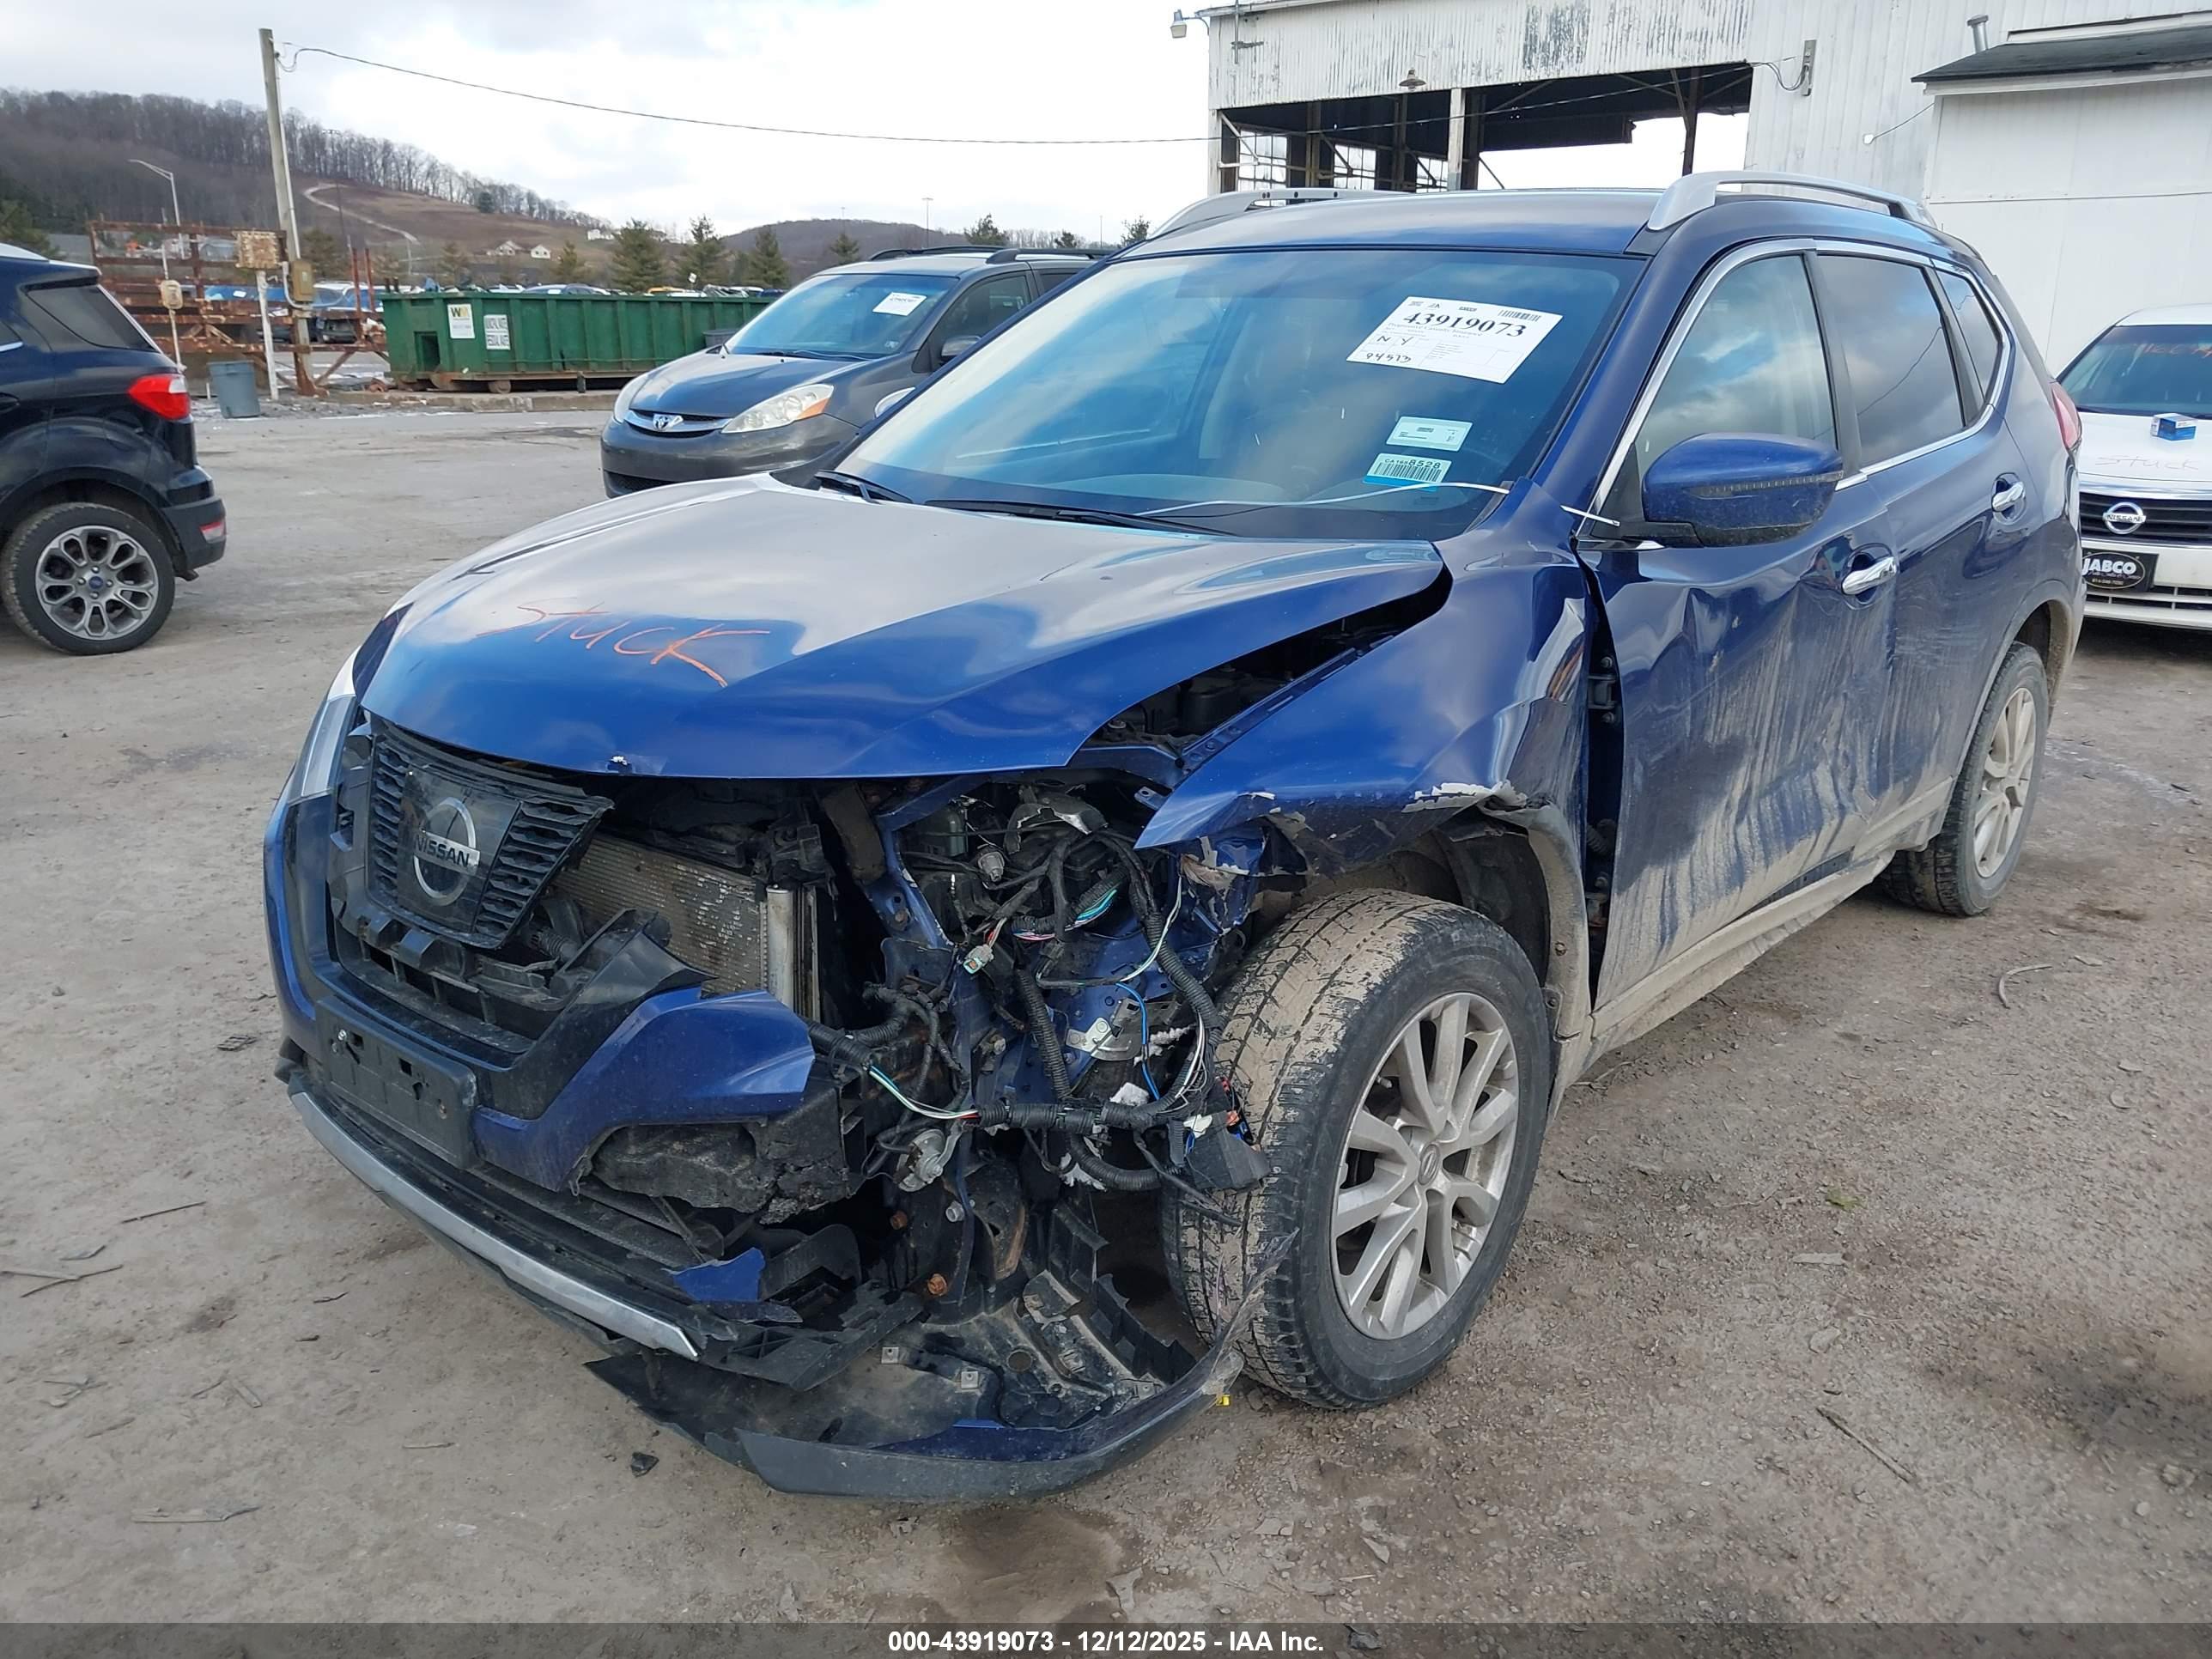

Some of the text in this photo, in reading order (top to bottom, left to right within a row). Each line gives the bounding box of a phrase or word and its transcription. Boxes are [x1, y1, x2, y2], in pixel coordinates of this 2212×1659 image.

[1403, 312, 1527, 337] 43919073
[2081, 558, 2136, 576] JABCO
[414, 835, 471, 867] NISSAN
